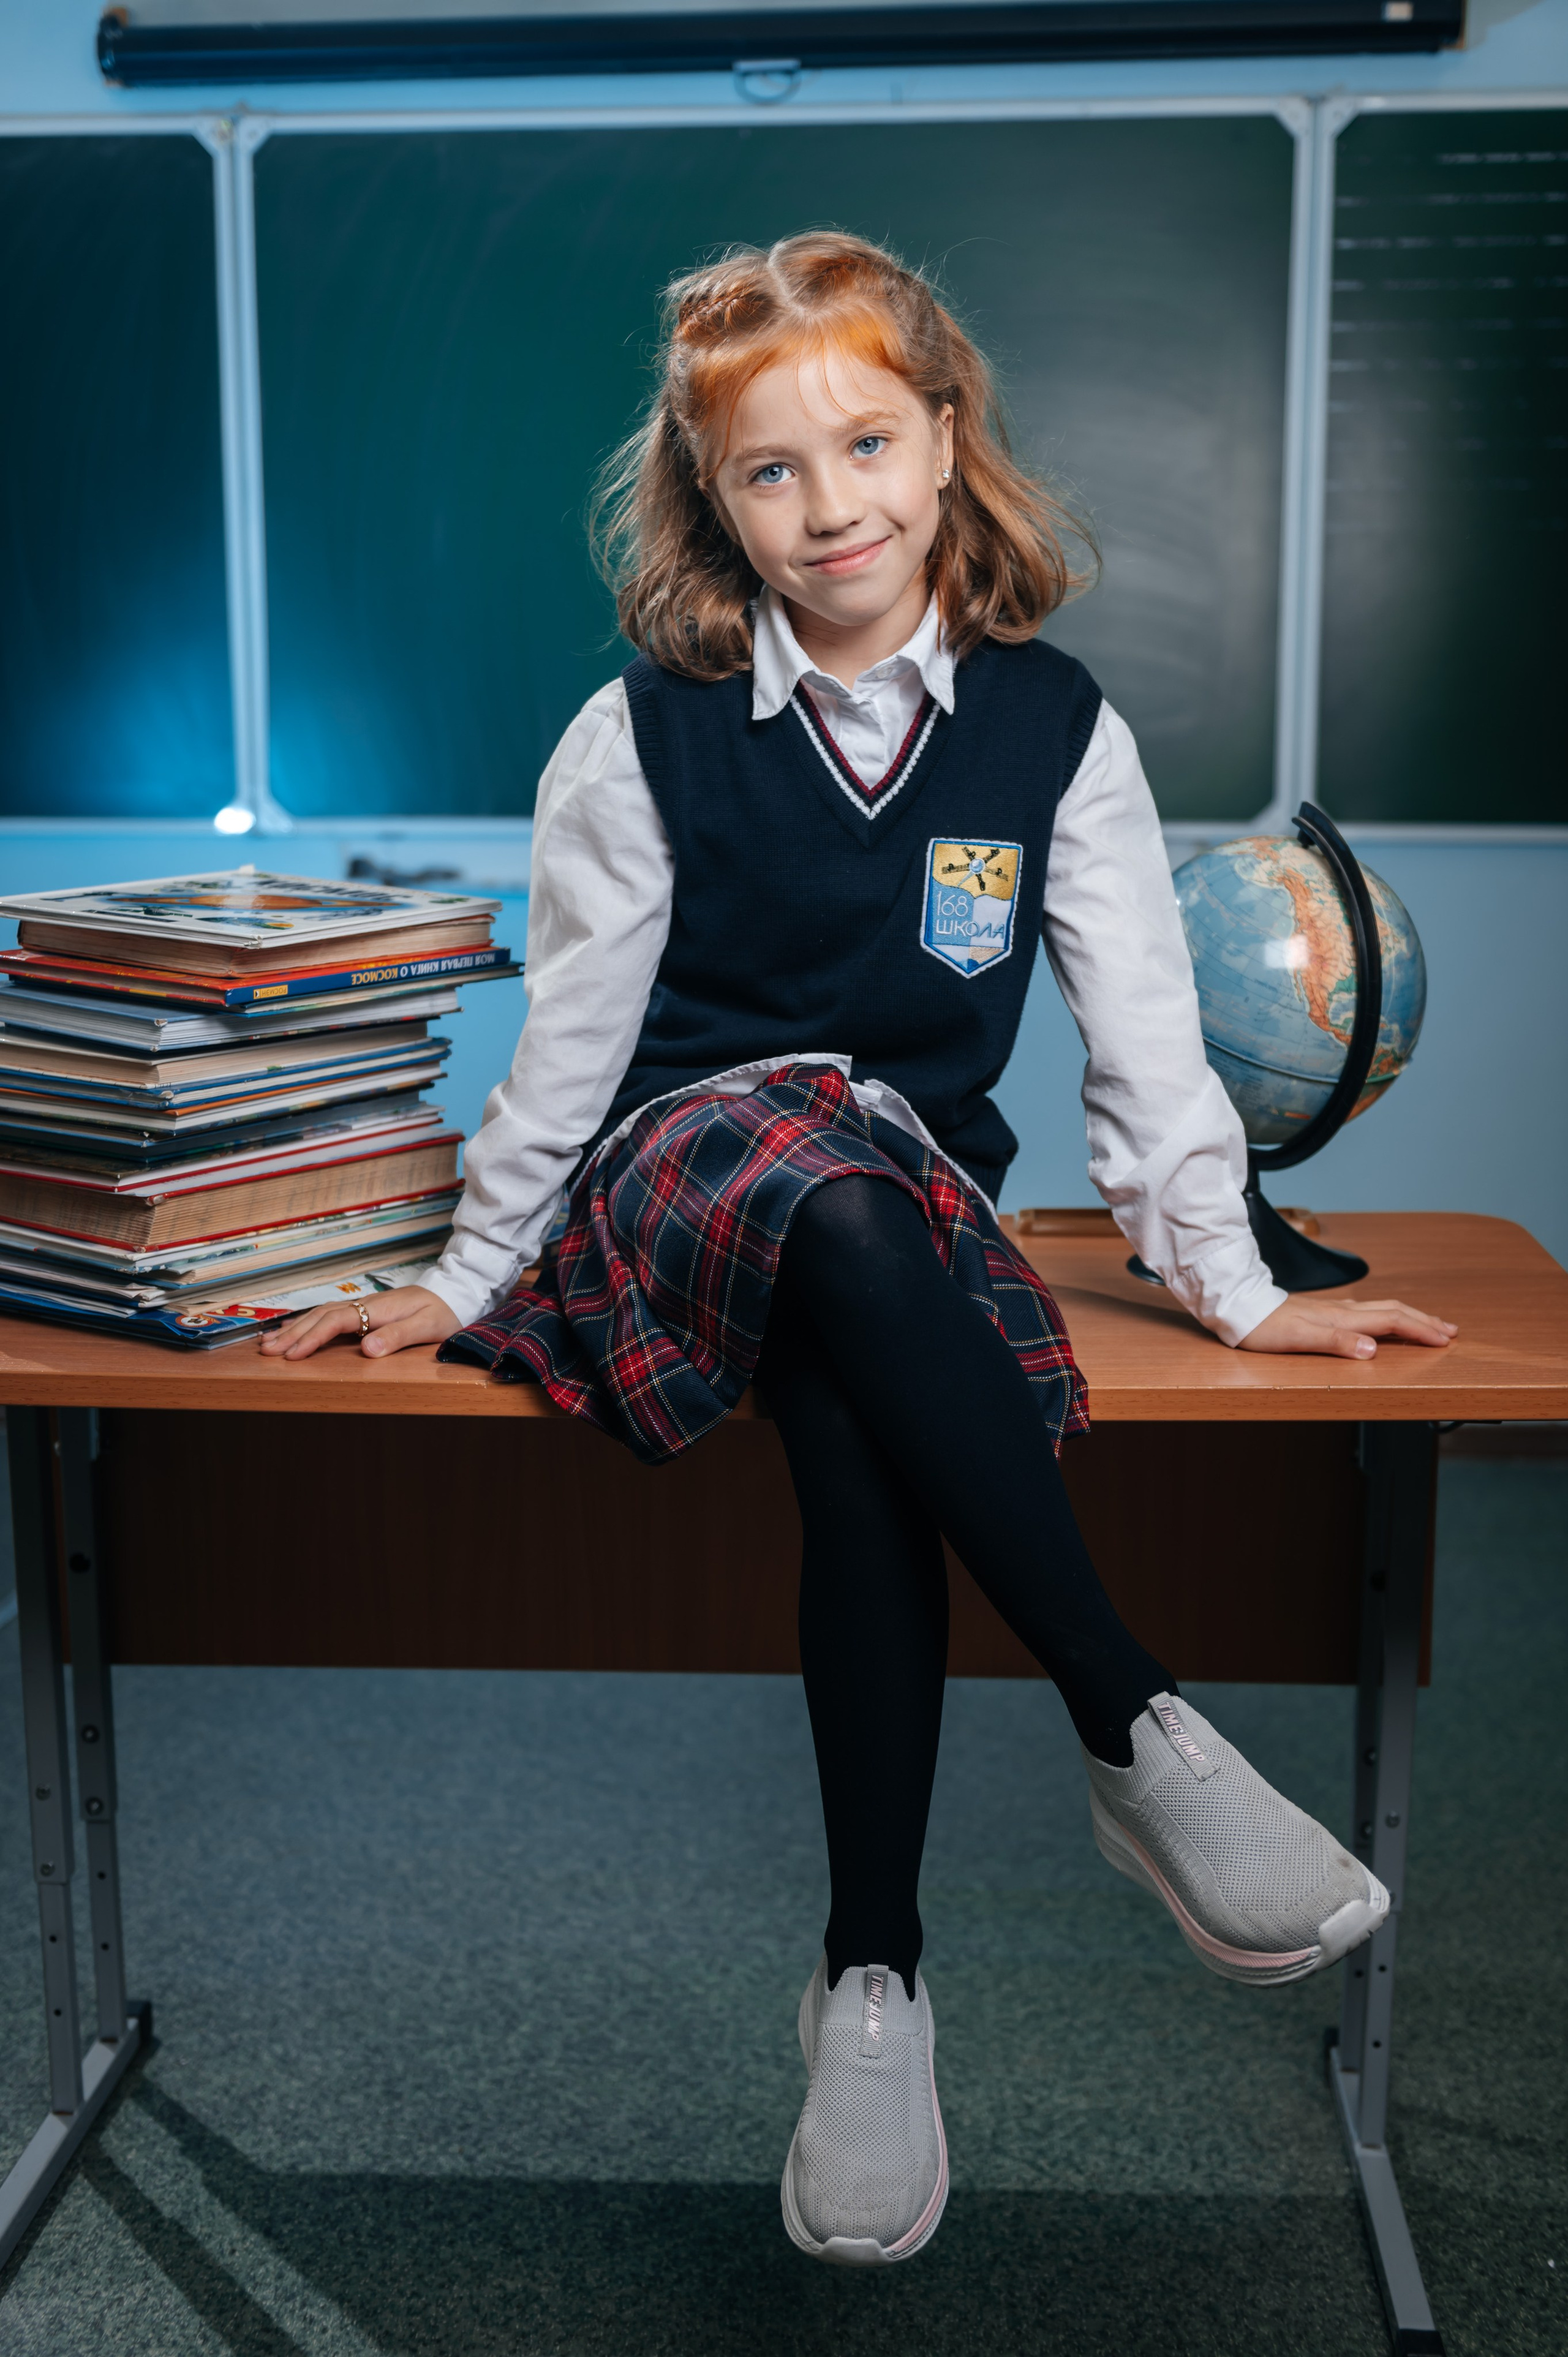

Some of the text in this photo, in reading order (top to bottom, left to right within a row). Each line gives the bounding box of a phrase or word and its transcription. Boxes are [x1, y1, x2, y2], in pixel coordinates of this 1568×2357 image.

[937, 891, 969, 917] 168
[935, 919, 1005, 939] ШКОЛА
[351, 952, 496, 986] МОЯ ПЕРВАЯ КНИГА О КОСМОСЕ
[262, 987, 287, 997] РОСМЭН
[1158, 1702, 1205, 1763] TIME JUMP
[867, 1975, 884, 2042] TIME JUMP
